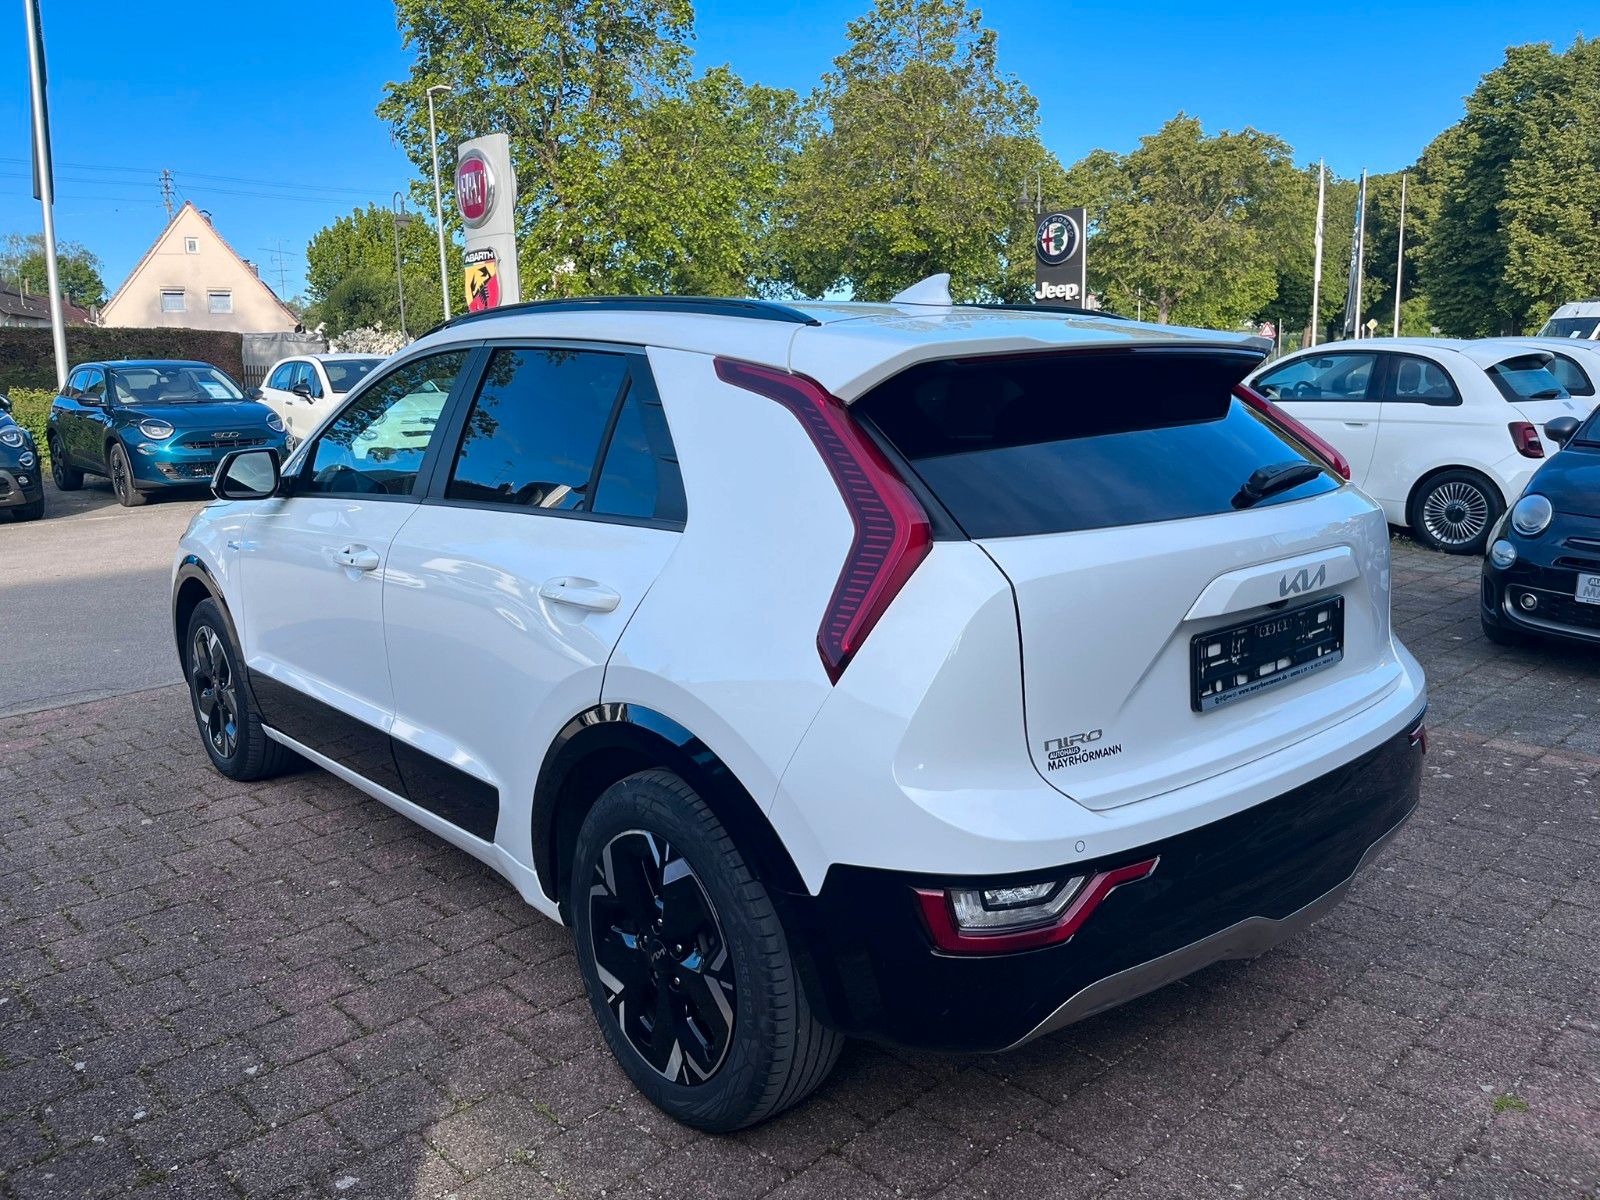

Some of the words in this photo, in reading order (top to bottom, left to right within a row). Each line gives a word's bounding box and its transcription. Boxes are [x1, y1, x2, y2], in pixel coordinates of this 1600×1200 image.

[459, 170, 483, 207] FIAT
[465, 250, 494, 263] ABARTH
[1279, 564, 1326, 597] KIA
[1044, 728, 1103, 752] NIRO
[1049, 746, 1080, 759] AUTOHAUS
[1047, 744, 1122, 771] MAYRHÖRMANN
